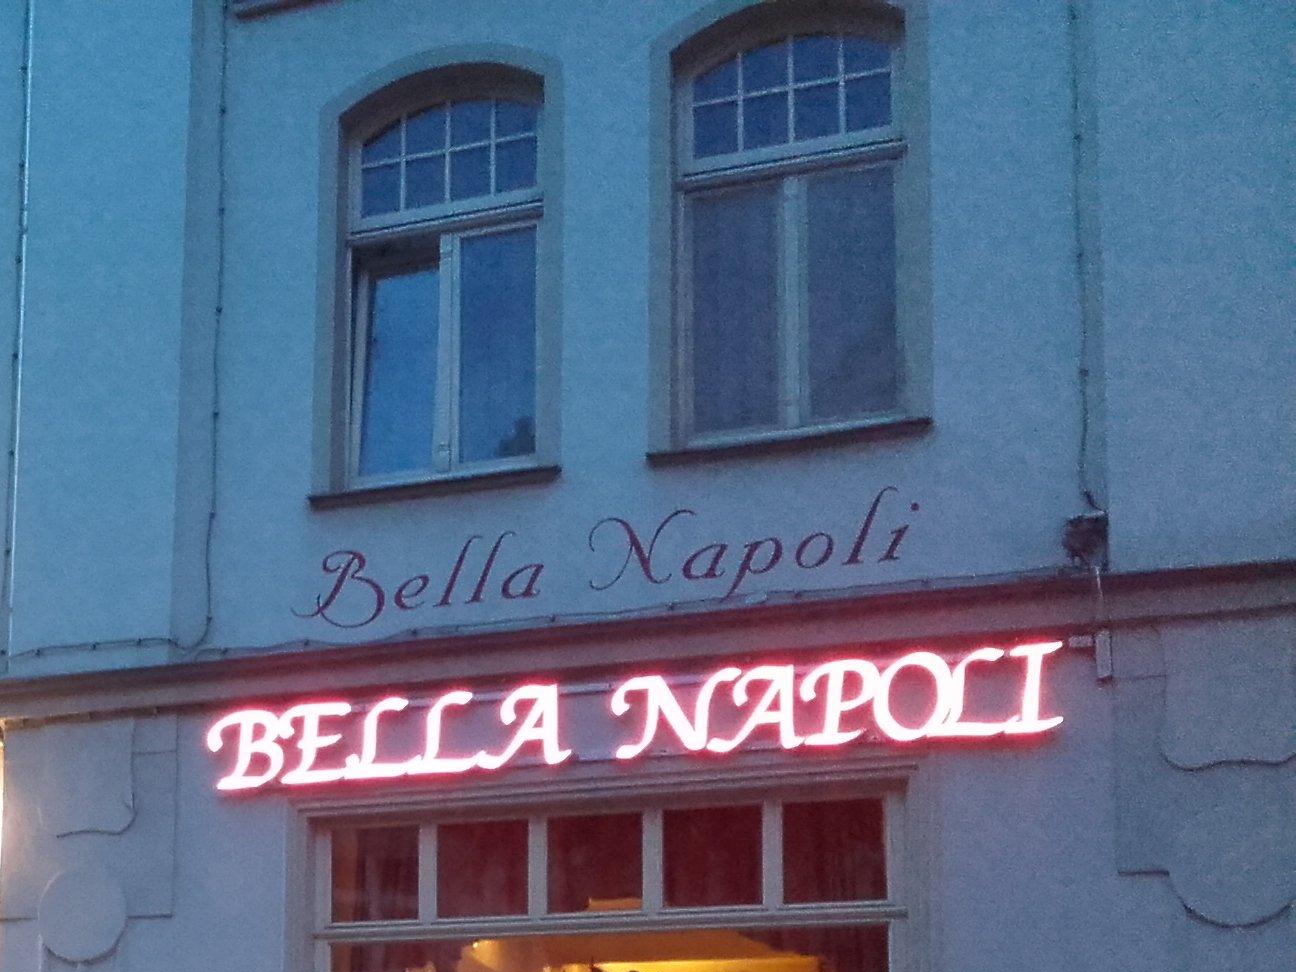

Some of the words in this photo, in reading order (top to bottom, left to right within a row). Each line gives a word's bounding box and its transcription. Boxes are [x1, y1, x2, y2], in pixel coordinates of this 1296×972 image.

[291, 531, 545, 628] Bella
[589, 486, 920, 599] Napoli
[206, 681, 572, 791] BELLA
[611, 640, 1064, 760] NAPOLI
